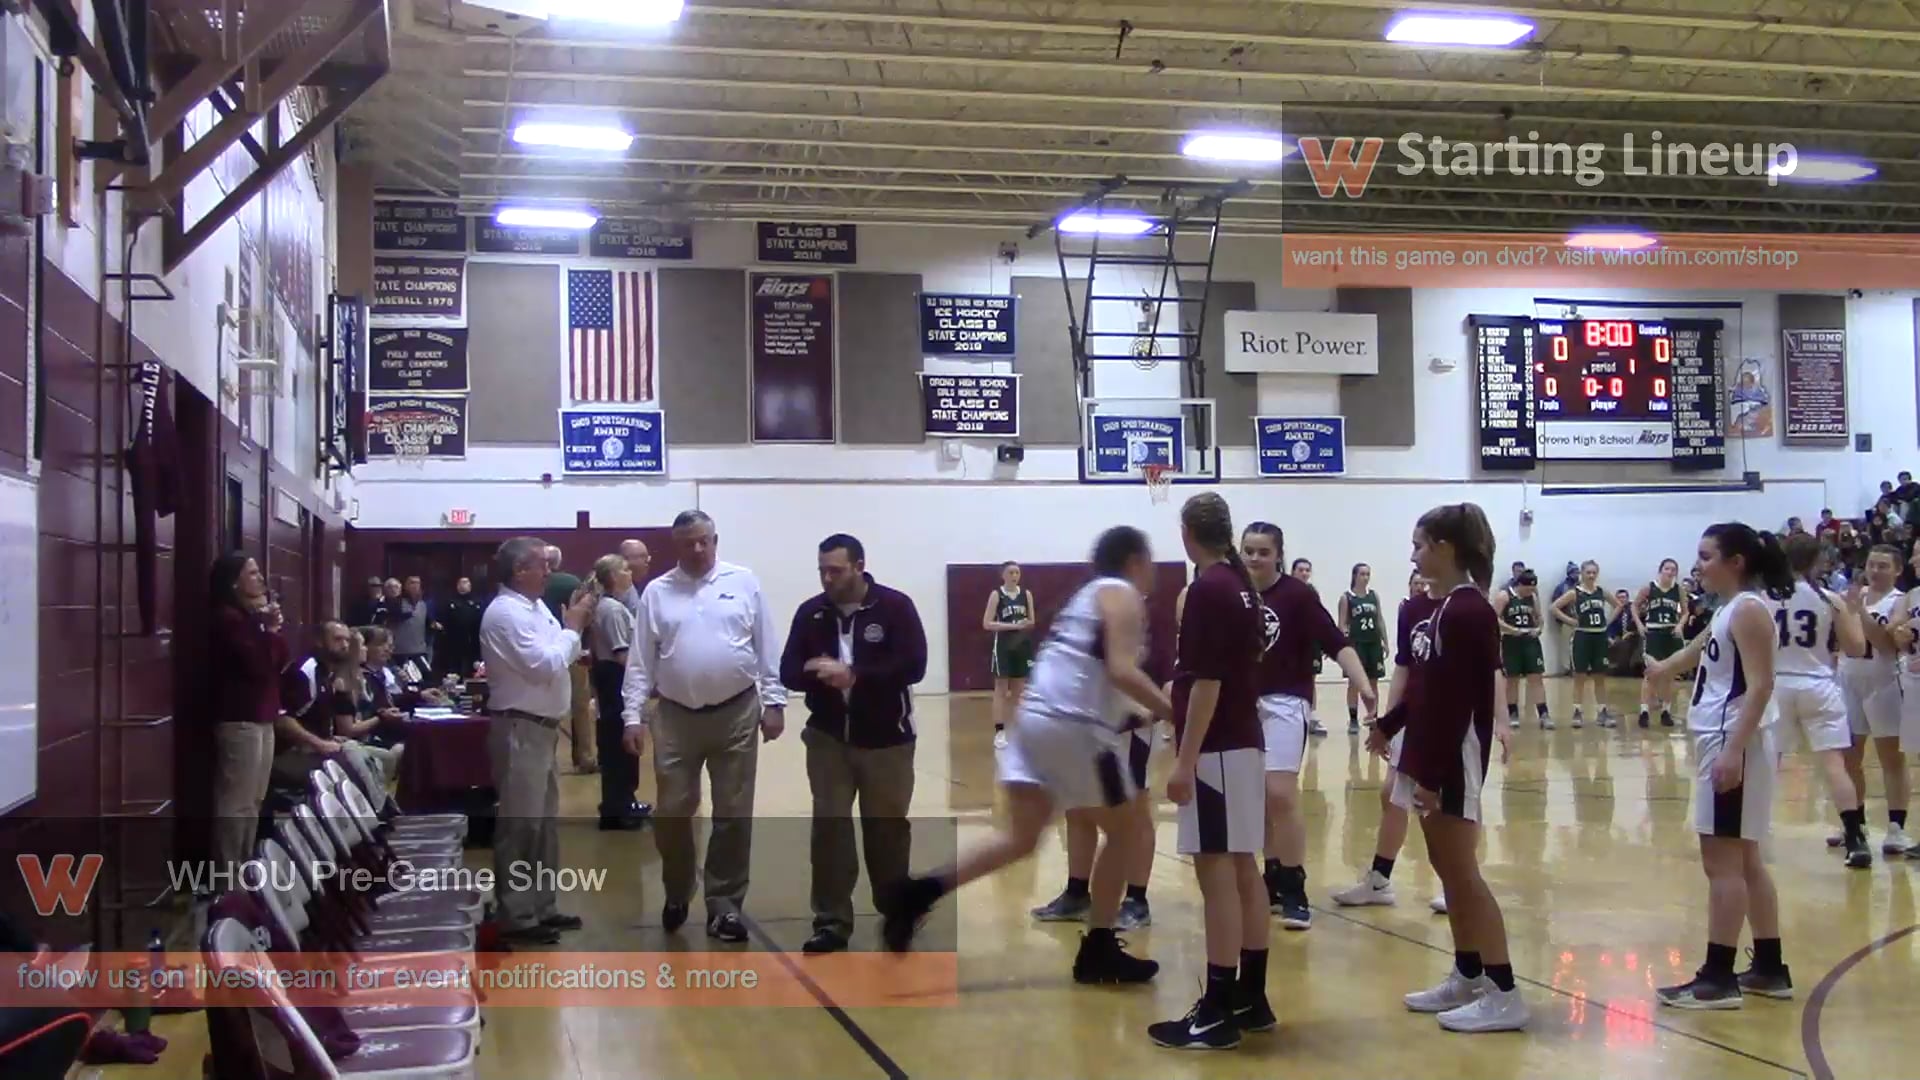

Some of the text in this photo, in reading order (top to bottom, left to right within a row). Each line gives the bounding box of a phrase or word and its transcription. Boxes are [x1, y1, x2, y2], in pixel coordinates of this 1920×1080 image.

[374, 222, 399, 232] TATE
[776, 227, 837, 239] CLASS B
[766, 239, 849, 251] STATE CHAMPIONS
[424, 267, 460, 277] SCHOOL
[374, 281, 457, 293] TATE CHAMPIONS
[935, 308, 1001, 319] ICE HOCKEY
[939, 319, 997, 330] CLASS B
[1539, 322, 1563, 334] Home
[1638, 324, 1667, 335] Guests
[928, 330, 1008, 342] STATE CHAMPIONS
[1585, 321, 1634, 347] 8:00
[1241, 331, 1289, 355] Riot
[1553, 336, 1568, 361] 0
[1655, 337, 1670, 363] 0
[1591, 362, 1617, 374] period
[1629, 358, 1636, 375] 1
[930, 378, 1009, 388] ORONO HIGH SCHOOL
[1545, 377, 1557, 397] 0
[1654, 378, 1666, 397] 0
[400, 400, 461, 417] HIGH SCHOOL
[940, 398, 985, 409] CLASS
[1590, 401, 1618, 413] player
[932, 409, 1009, 421] STATE CHAMPIONS
[403, 424, 459, 435] CHAMPIONS
[592, 415, 652, 432] SPORTSMANSHIP
[1121, 419, 1174, 434] SPORTSMANSHIP
[1283, 422, 1334, 436] SPORTSMANSHIP
[593, 427, 630, 437] AWARD
[1284, 431, 1315, 441] AWARD
[1538, 434, 1634, 448] Orono High School
[622, 460, 657, 468] COUNTRY
[1360, 617, 1375, 631] 24
[1589, 613, 1601, 626] 10
[1775, 608, 1817, 649] 13
